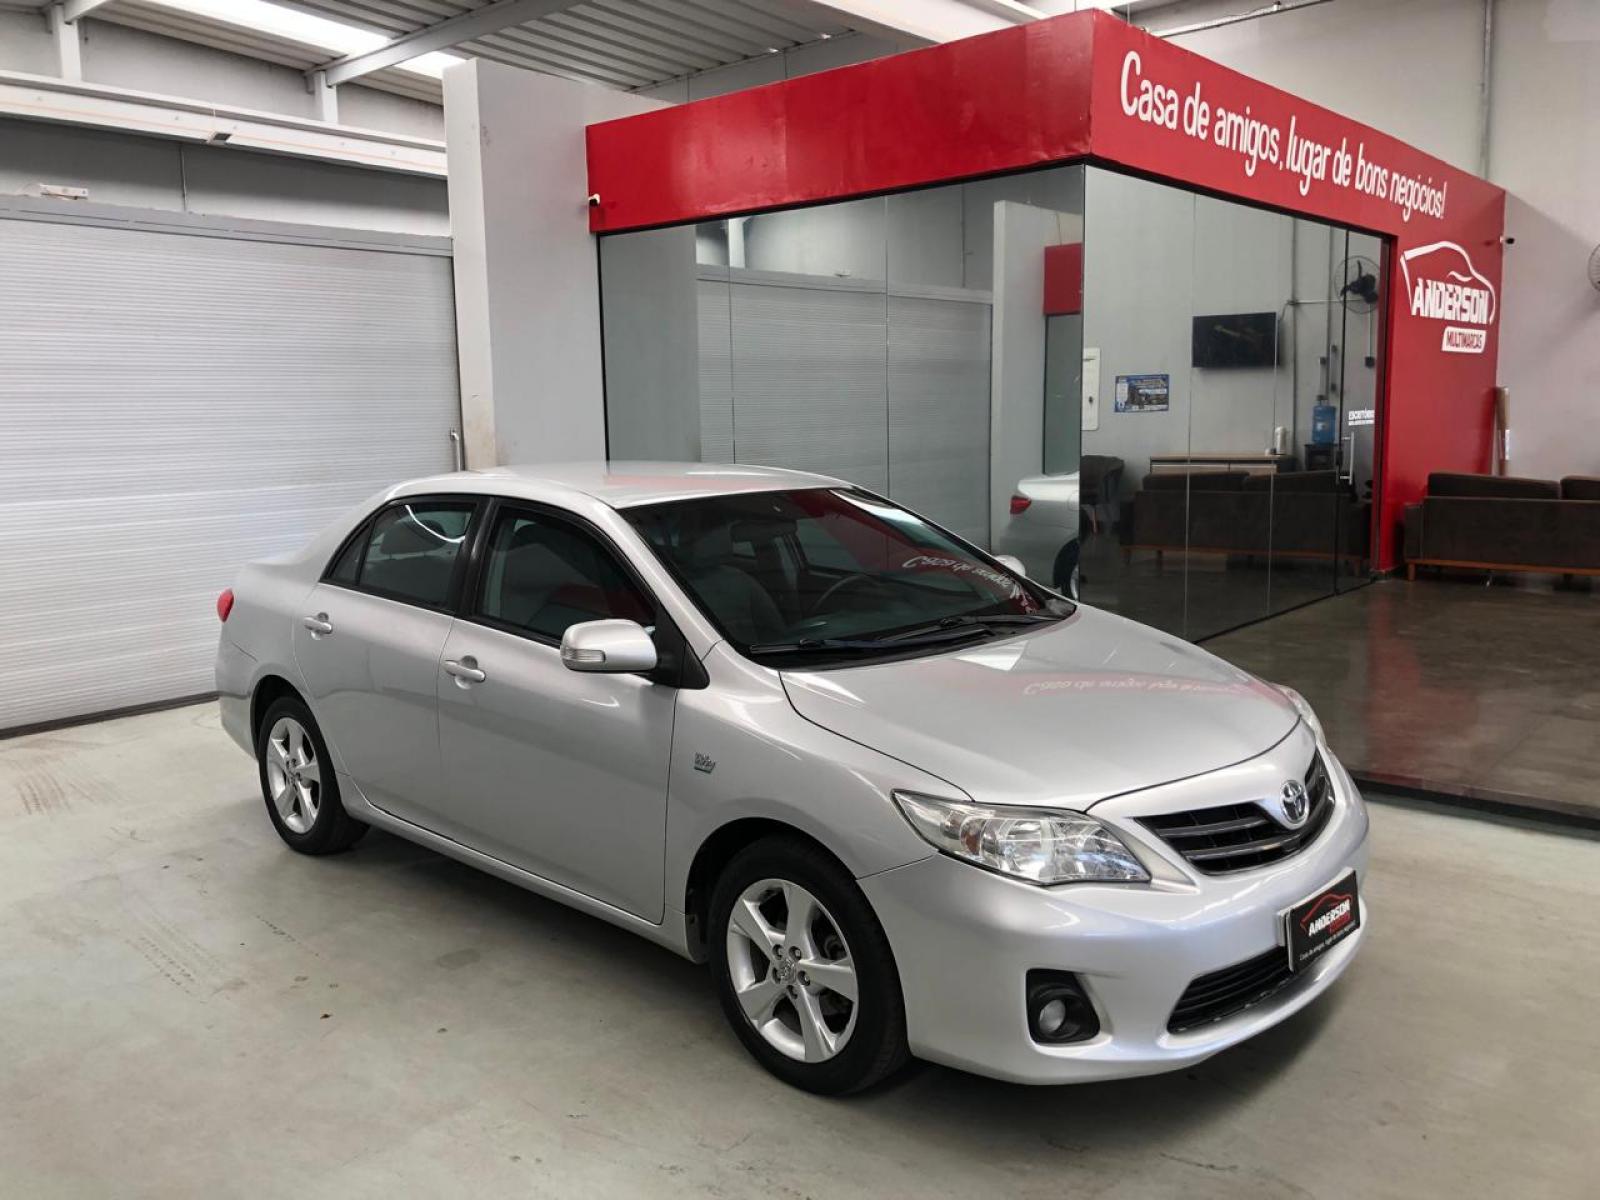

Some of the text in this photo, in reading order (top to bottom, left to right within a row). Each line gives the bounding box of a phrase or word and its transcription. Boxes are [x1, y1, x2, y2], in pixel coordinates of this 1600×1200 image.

[1121, 51, 1447, 222] Casa de amigos, lugar de bons negócios!
[1411, 278, 1489, 324] ANDERSON
[1308, 898, 1350, 937] ANDERSON
